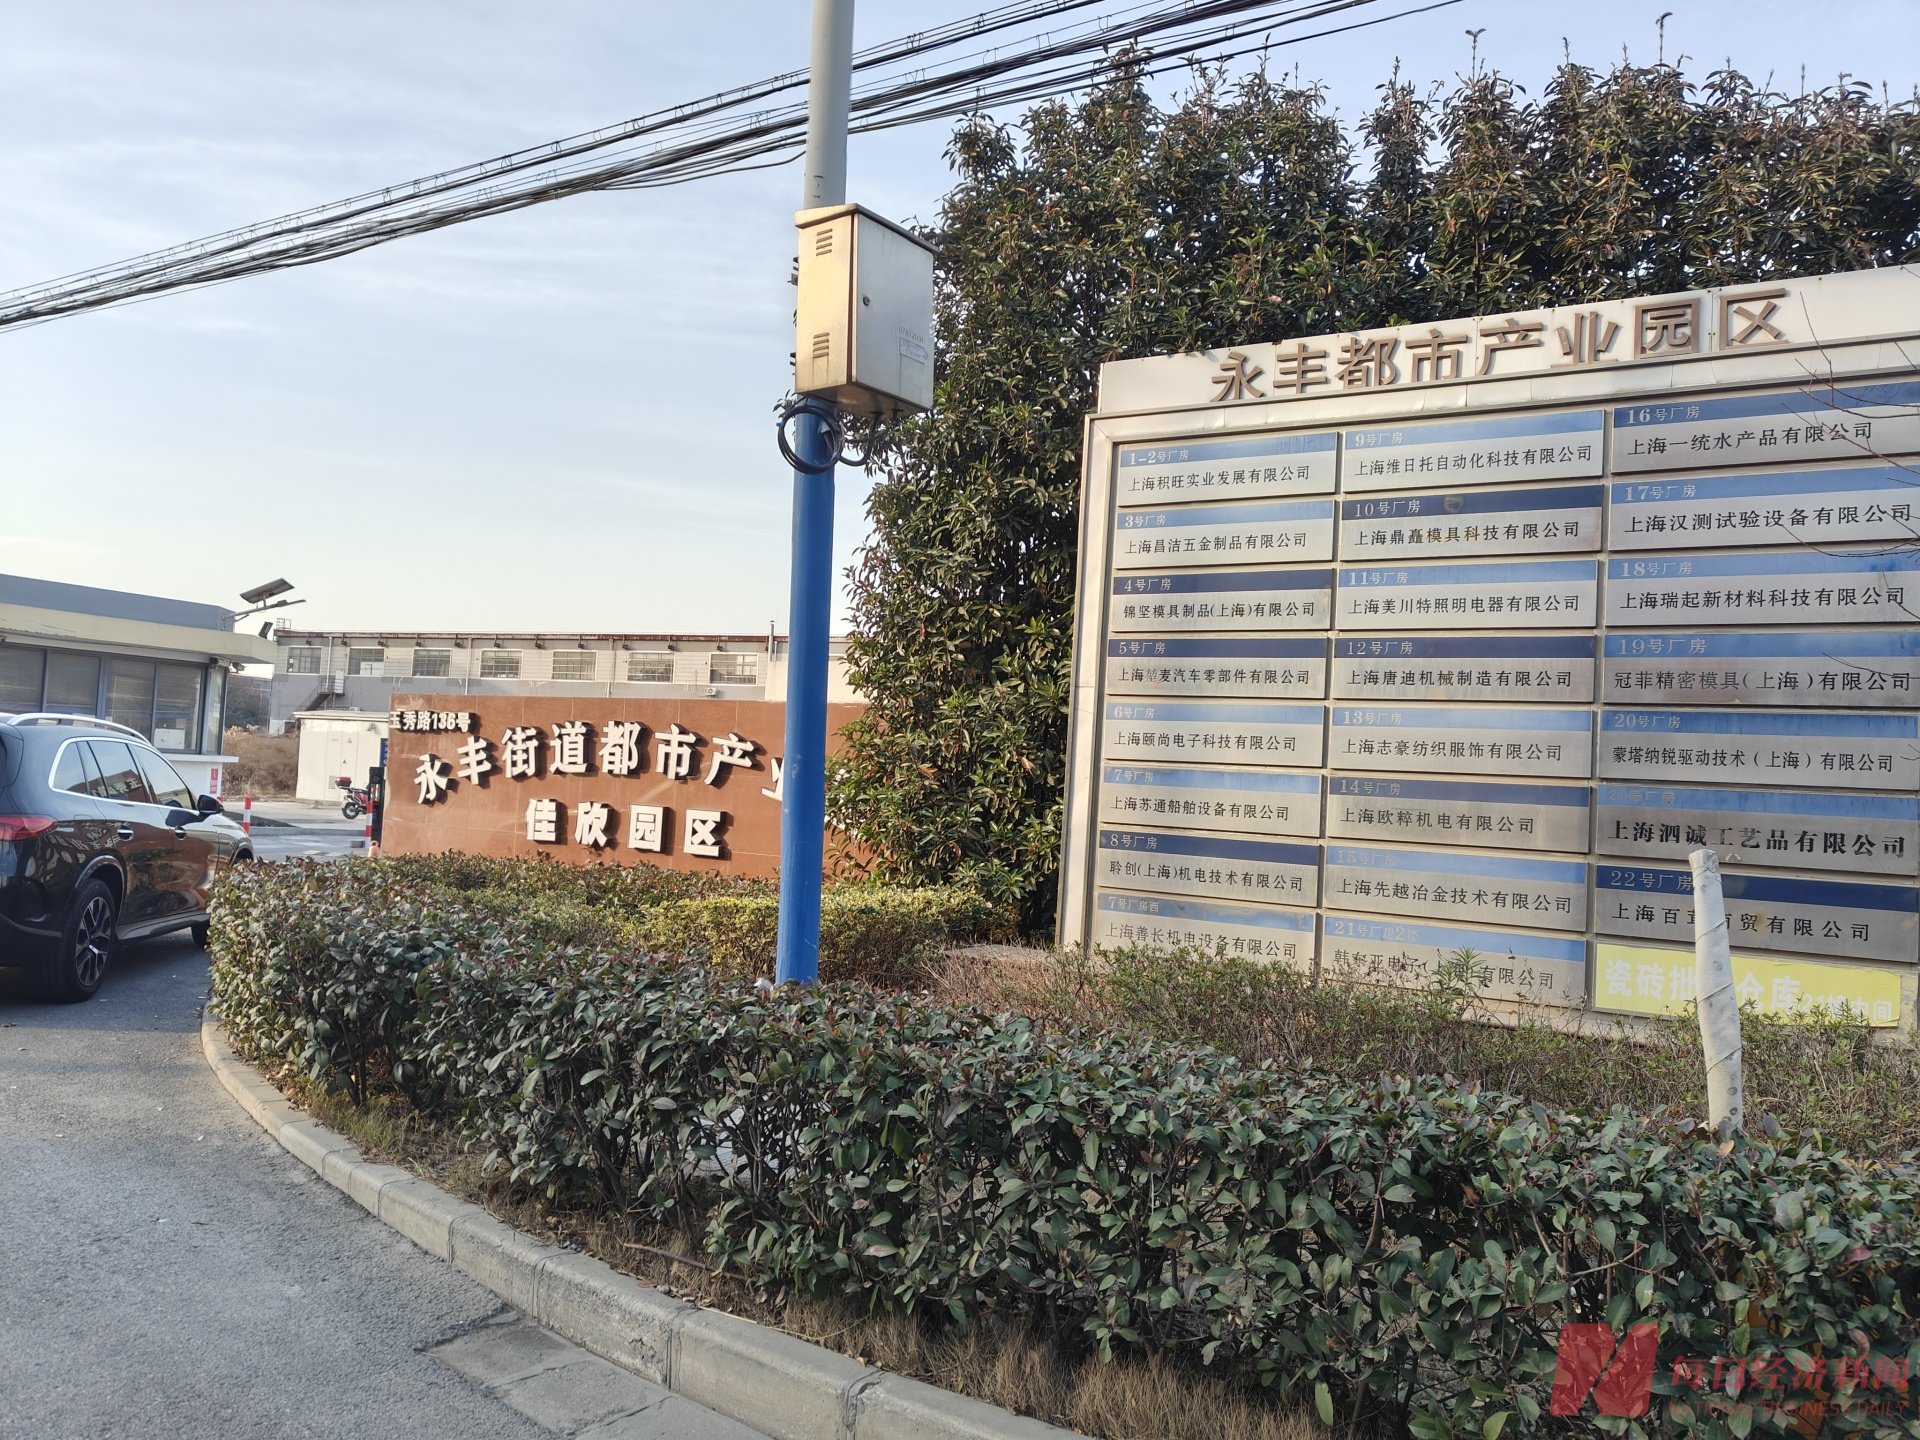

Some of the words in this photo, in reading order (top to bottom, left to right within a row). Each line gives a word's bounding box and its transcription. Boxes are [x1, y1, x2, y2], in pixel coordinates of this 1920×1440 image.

[1211, 287, 1790, 401] 永丰都市产业园区
[1627, 405, 1700, 423] 16号厂房
[1355, 432, 1403, 447] 9号厂房
[1627, 422, 1872, 456] 上海一统水产品有限公司
[1129, 448, 1189, 465] 1-2号厂房
[1354, 445, 1592, 476] 上海维日托自动化科技有限公司
[1128, 465, 1310, 492] 上海积旺实业发展有限公司
[1624, 483, 1697, 501] 17号厂房
[1354, 500, 1421, 517] 10号厂房
[1125, 514, 1166, 528] 3号厂房
[1624, 503, 1911, 534] 上海汉测试验设备有限公司
[1124, 532, 1307, 555] 上海昌洁五金制品有限公司
[1620, 561, 1693, 577] 18号厂房
[1124, 577, 1172, 593] 4号厂房
[1349, 571, 1408, 586] 11号厂房
[1347, 595, 1580, 616] 上海美川特照明电器有限公司
[1619, 587, 1905, 610] 上海瑞起新材料科技有限公司
[1123, 602, 1315, 620] 锦坚模具制品(上海)有限公司
[1118, 641, 1166, 655] 5号厂房
[1346, 641, 1414, 656] 12号厂房
[1617, 638, 1708, 655] 19号厂房
[1346, 669, 1572, 688] 上海唐迪机械制造有限公司
[1613, 671, 1911, 692] 冠菲精密模具(上海)有限公司
[1114, 706, 1156, 719] 6号厂房
[1343, 710, 1402, 725] 13号厂房
[1614, 713, 1681, 729] 20号厂房
[1113, 731, 1296, 752] 上海颐尚电子科技有限公司
[1342, 739, 1562, 762] 上海志豪纺织服饰有限公司
[1114, 769, 1154, 783] 7号厂房
[1340, 779, 1401, 795] 14号厂房
[1110, 795, 1290, 821] 上海苏通船舶设备有限公司
[525, 798, 724, 857] 佳欣园区
[1110, 833, 1158, 850] 8号厂房
[1611, 870, 1692, 891] 22号厂房
[1108, 896, 1160, 913] 7号厂房西
[1336, 878, 1572, 914] 上海先越冶金技术有限公司
[1605, 958, 1800, 1013] 瓷砖批仓库
